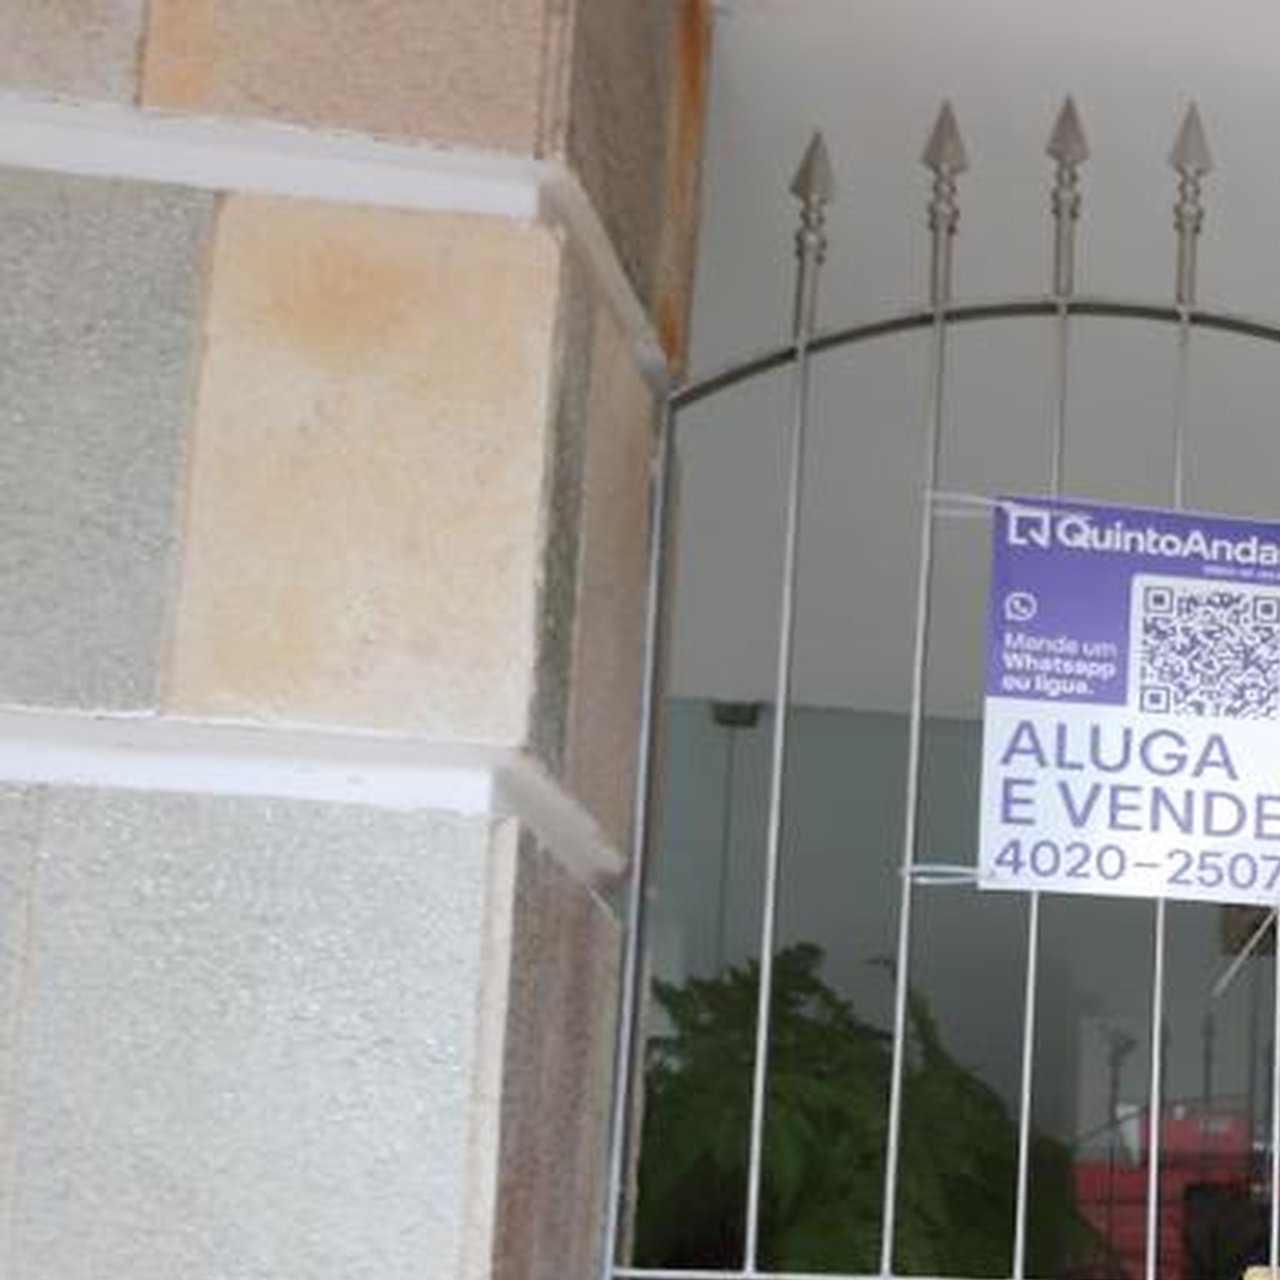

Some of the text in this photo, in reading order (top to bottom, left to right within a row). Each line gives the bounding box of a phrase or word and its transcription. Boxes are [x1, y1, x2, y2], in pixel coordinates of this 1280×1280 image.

[1003, 632, 1118, 659] Mande um
[1002, 653, 1117, 681] Whatsapp
[1002, 675, 1031, 692] ou
[1000, 719, 1239, 781] ALUGA
[1001, 778, 1037, 826] E
